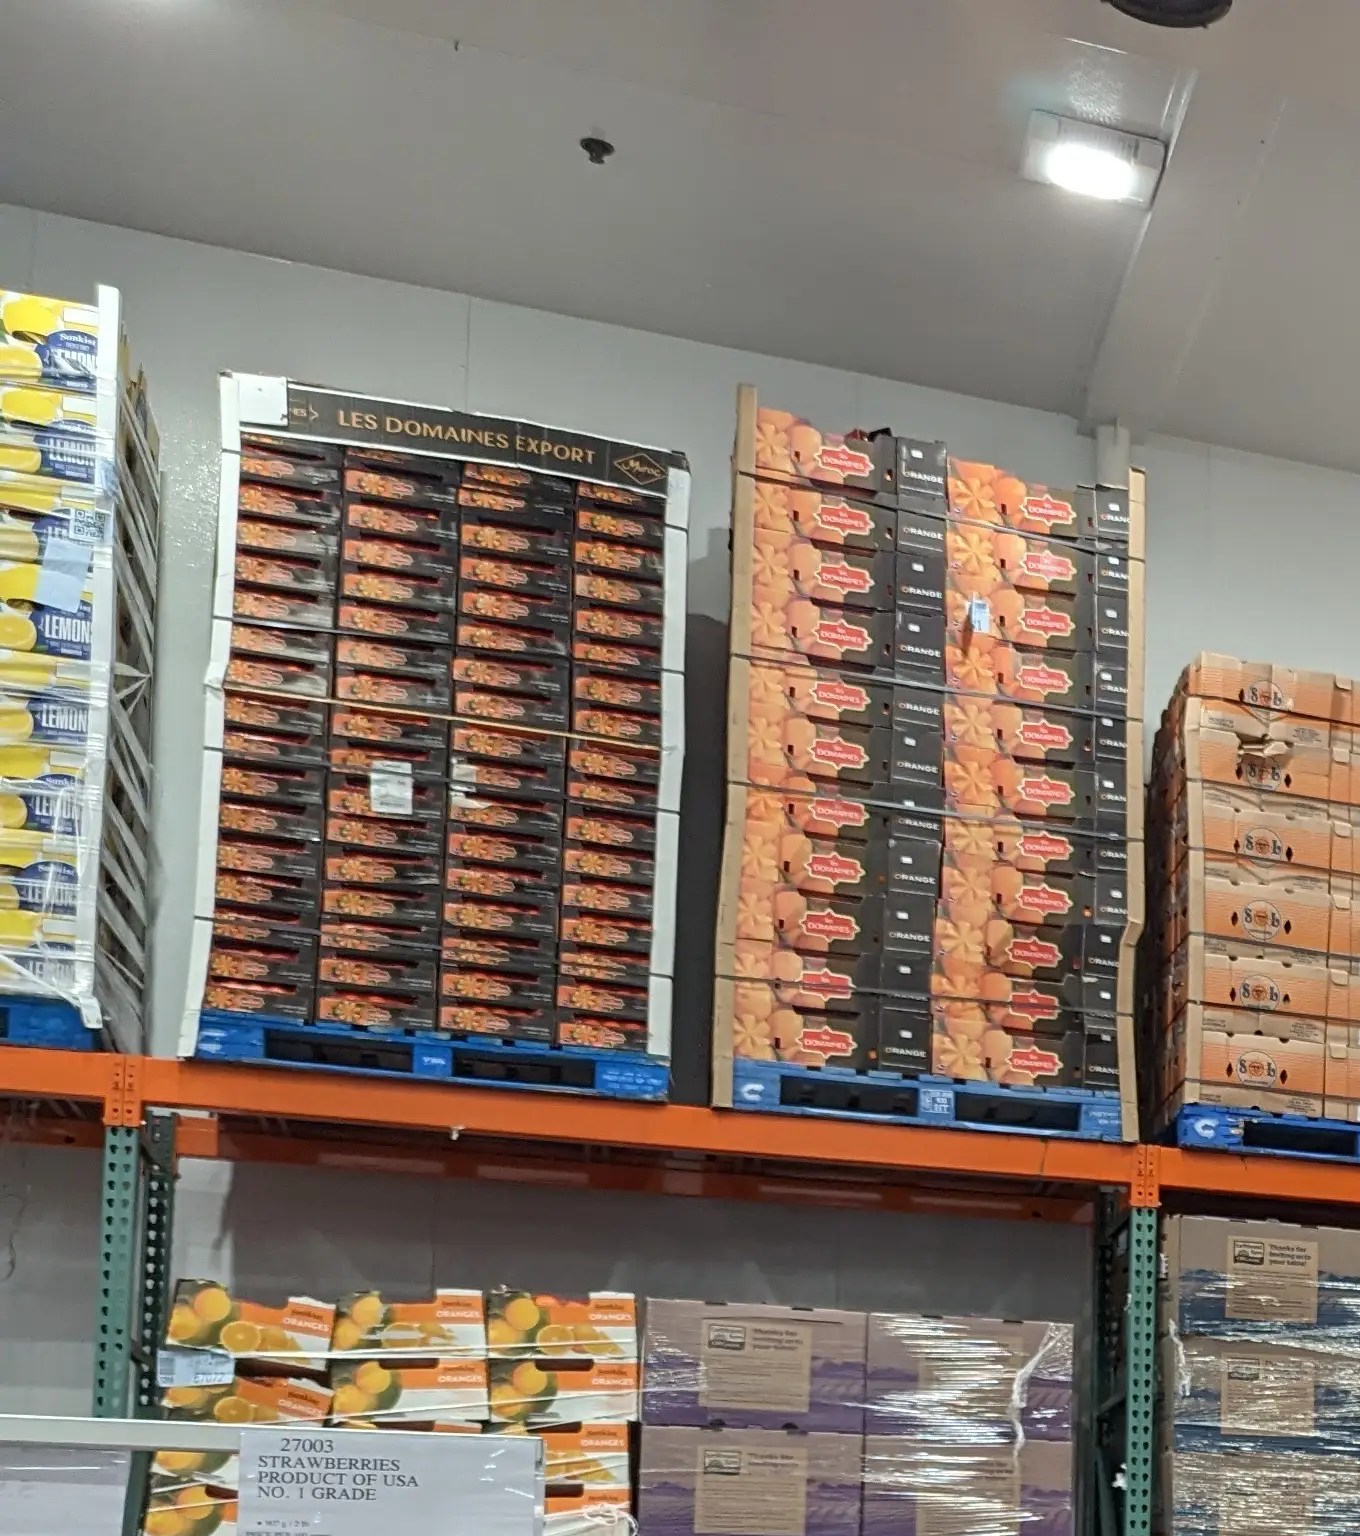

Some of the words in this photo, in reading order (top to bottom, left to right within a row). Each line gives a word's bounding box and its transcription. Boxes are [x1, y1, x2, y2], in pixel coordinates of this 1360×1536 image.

[338, 409, 377, 432] LES
[386, 417, 509, 449] DOMAINES
[515, 436, 596, 466] EXPORT
[904, 471, 944, 485] ORANGE
[903, 526, 943, 541] ORANGE
[901, 585, 942, 599] ORANGE
[41, 702, 88, 733] LEMON
[895, 872, 936, 885] ORANGE
[886, 1047, 926, 1058] ORANGE
[436, 1309, 482, 1318] ORANGES
[283, 1316, 329, 1332] ORANGES
[438, 1374, 483, 1384] ORANGES
[281, 1438, 334, 1453] 27003
[258, 1455, 400, 1472] STRAWBERRIES
[258, 1470, 344, 1486] PRODUCT
[352, 1473, 377, 1486] OF
[384, 1474, 419, 1488] USA
[257, 1486, 290, 1500] NO.
[312, 1486, 377, 1501] GRADE
